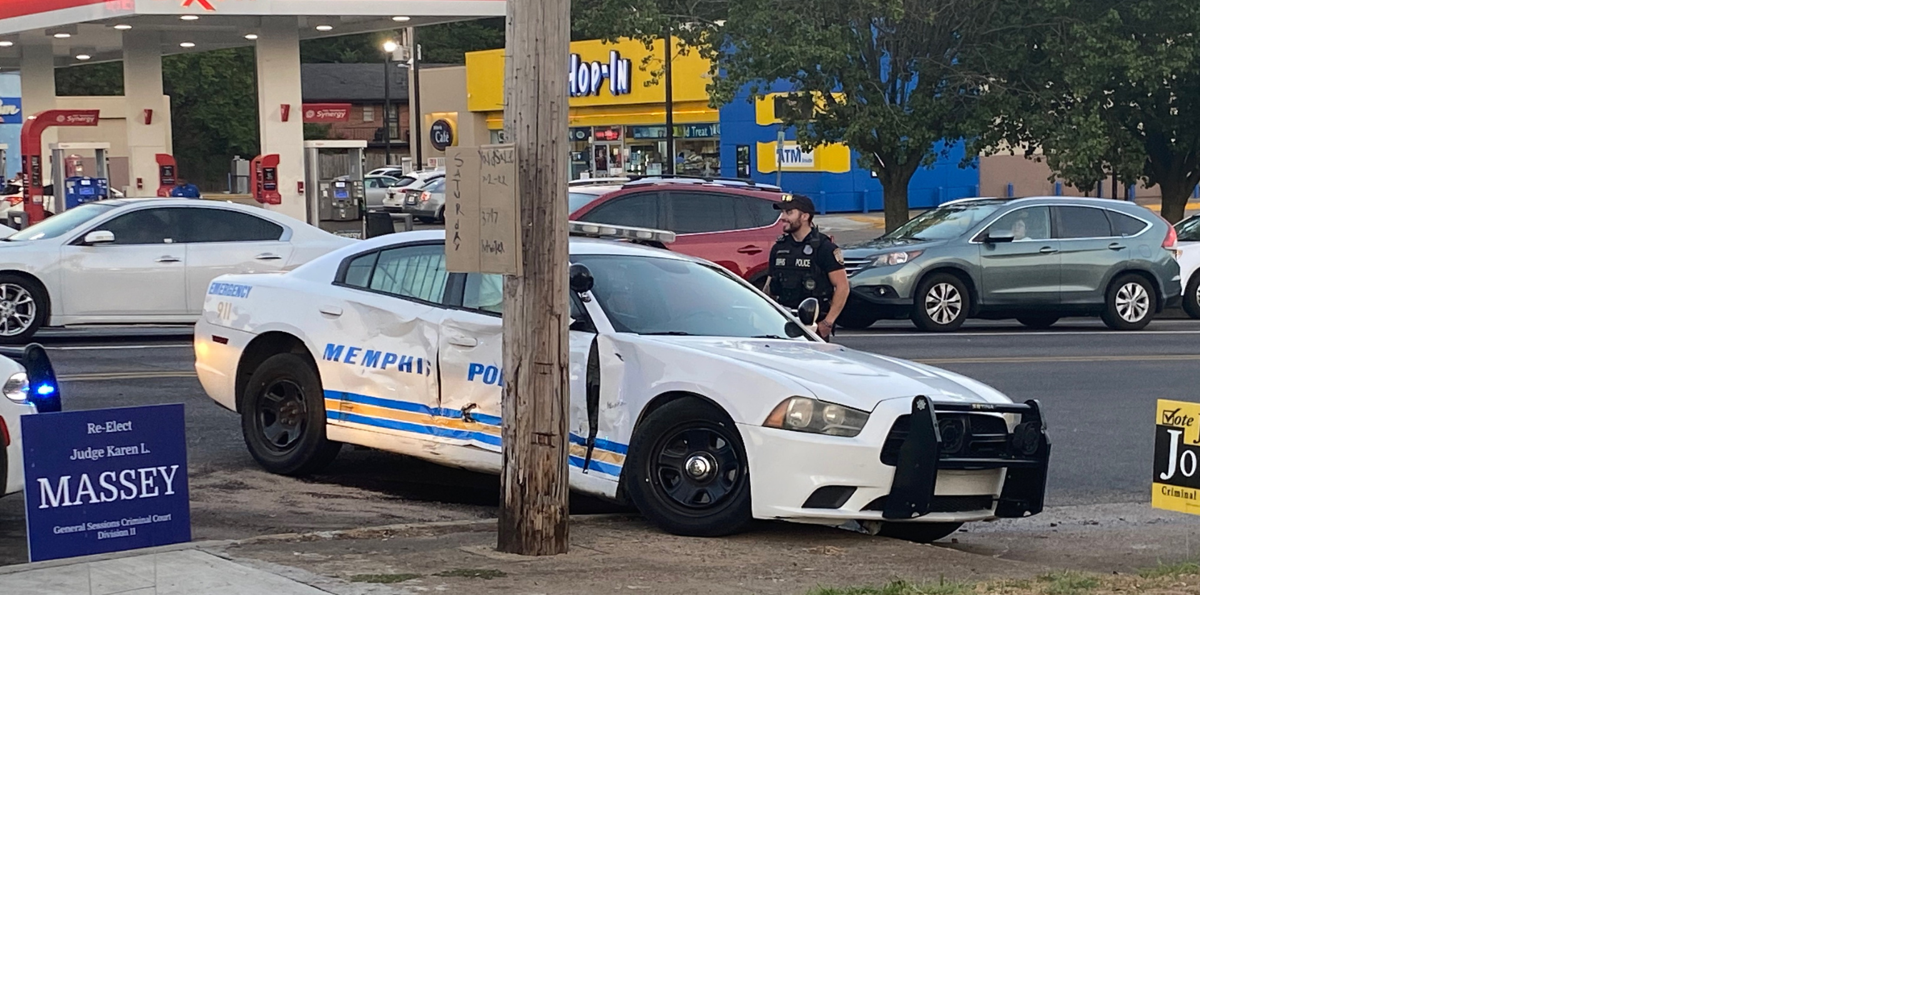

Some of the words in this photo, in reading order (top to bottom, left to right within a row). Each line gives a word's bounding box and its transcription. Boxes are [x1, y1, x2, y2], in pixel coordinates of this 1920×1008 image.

[67, 115, 95, 123] Synergy
[316, 110, 346, 119] Synergy
[691, 125, 709, 137] Treat
[776, 148, 801, 164] ATM
[795, 258, 811, 267] POLICE
[208, 282, 252, 298] EMERGENCY
[217, 301, 232, 320] 911
[87, 420, 132, 434] Re-Elect
[69, 449, 104, 460] Judge
[106, 444, 139, 457] Karen
[140, 442, 150, 454] L.
[36, 464, 179, 509] MASSEY
[1161, 485, 1197, 500] Criminal
[53, 523, 86, 534] General
[87, 518, 121, 530] Sessions
[121, 515, 152, 526] Criminal
[152, 513, 172, 522] Court
[97, 531, 129, 540] Division
